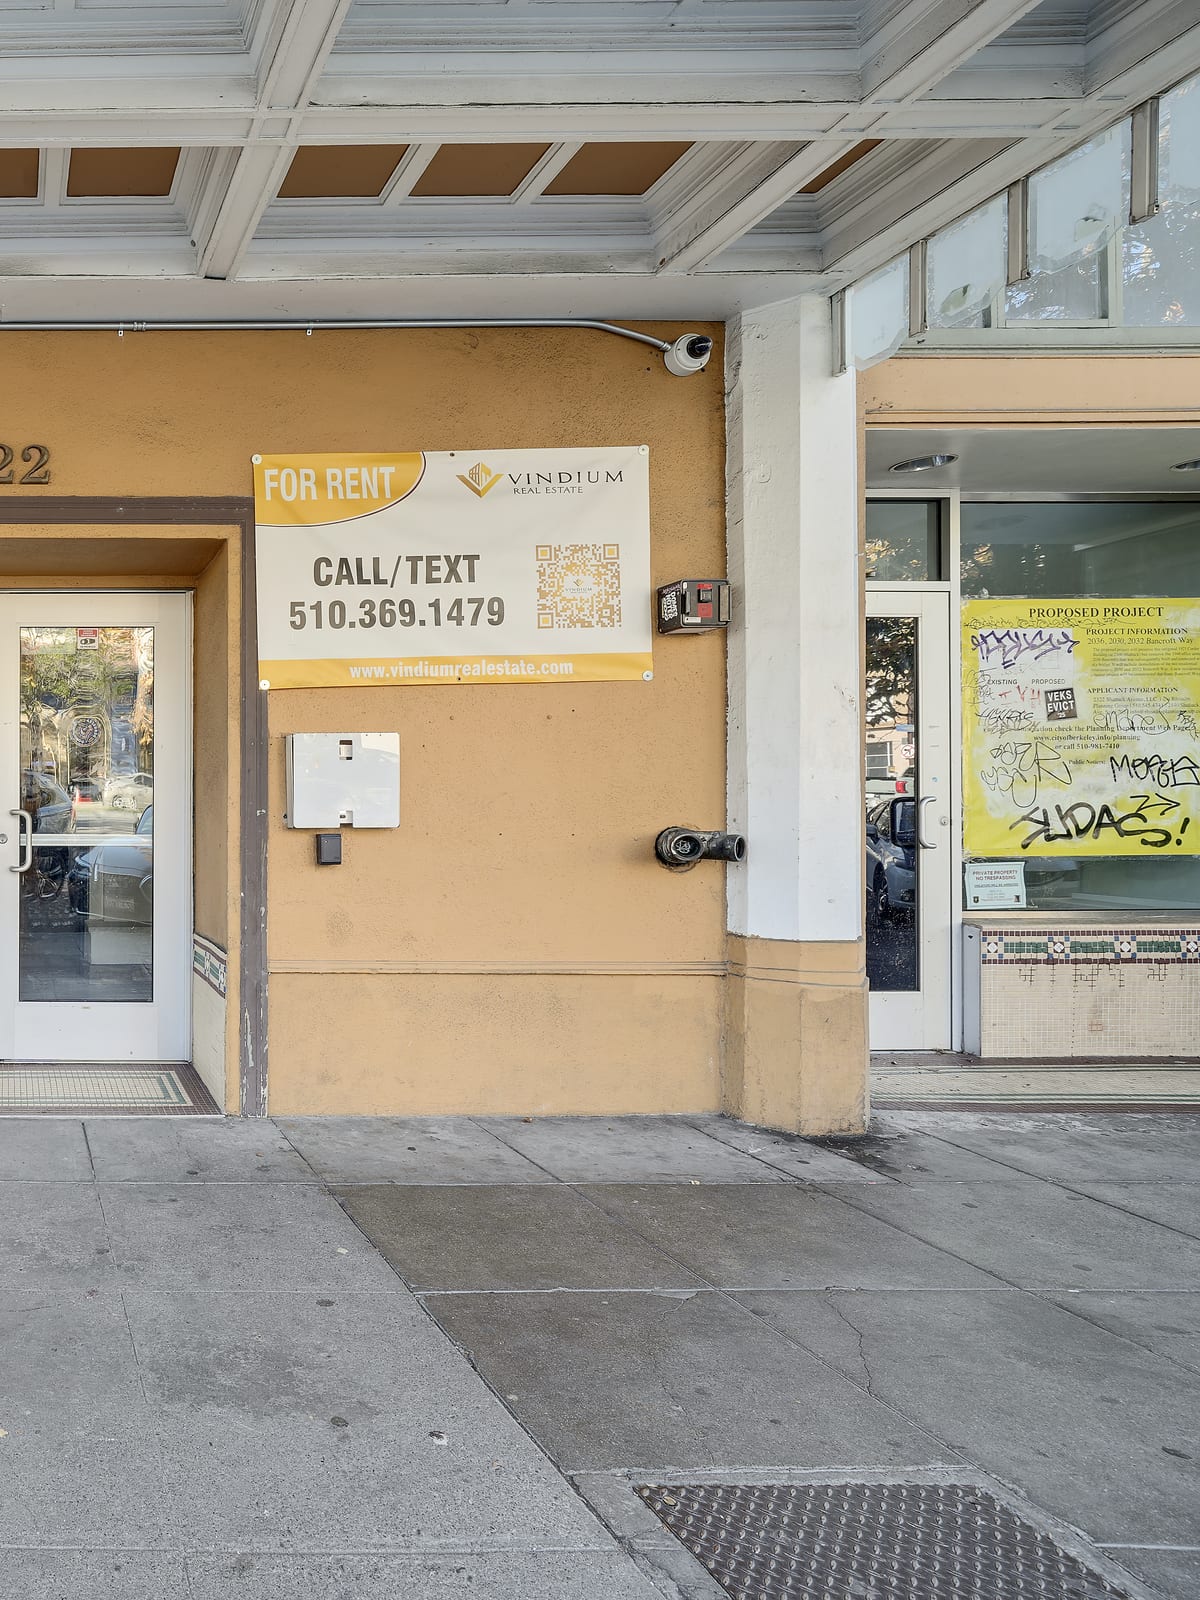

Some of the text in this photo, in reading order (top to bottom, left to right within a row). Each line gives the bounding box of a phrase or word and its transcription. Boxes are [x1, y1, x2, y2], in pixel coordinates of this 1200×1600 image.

[264, 466, 396, 502] FOR RENT
[508, 470, 624, 485] VINDIUM
[513, 486, 583, 495] REAL ESTATE
[313, 554, 481, 588] CALL/TEXT
[289, 597, 505, 631] 510.369.1479
[1029, 606, 1164, 618] PROPOSED PROJECT
[1178, 636, 1193, 646] Way
[349, 660, 574, 679] www.vindiumrealestate.com
[1048, 690, 1072, 702] VEKS
[1047, 700, 1075, 712] EVICT
